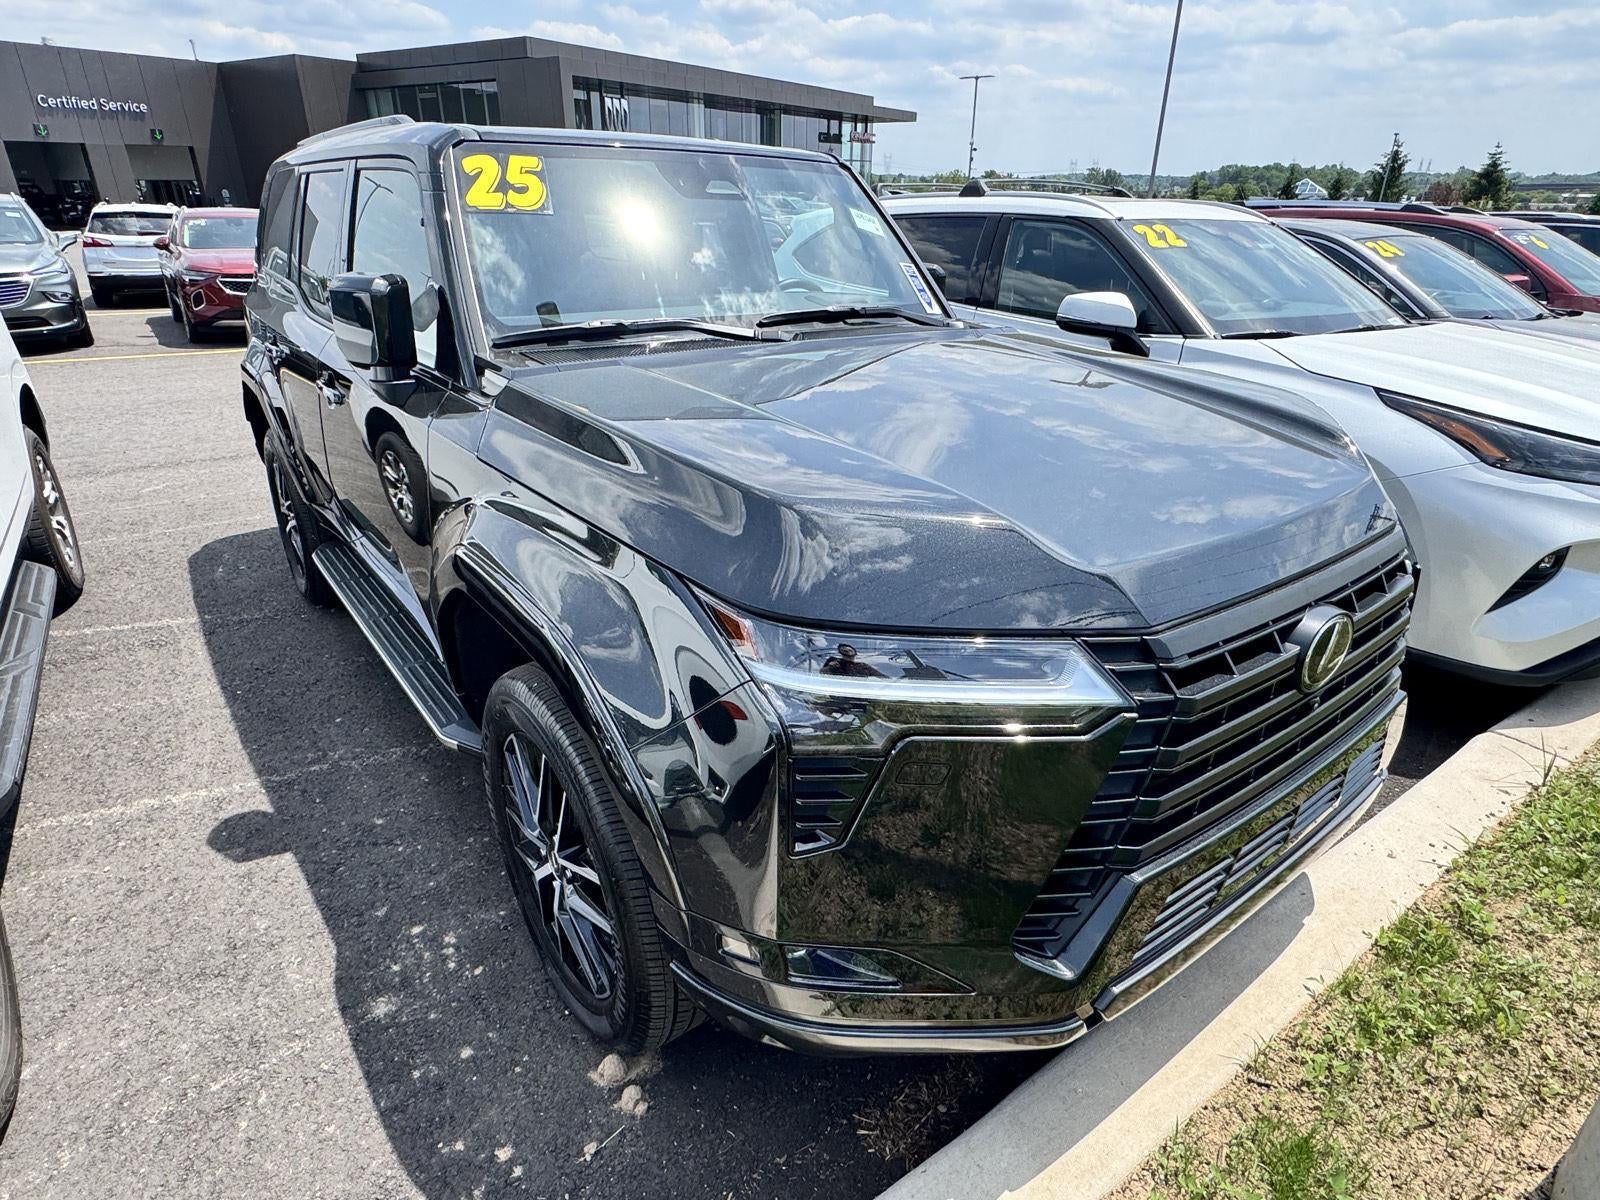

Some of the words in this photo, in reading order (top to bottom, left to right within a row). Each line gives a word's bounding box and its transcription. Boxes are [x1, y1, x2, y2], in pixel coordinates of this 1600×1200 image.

[37, 94, 98, 110] Certified
[99, 98, 148, 112] Service
[461, 154, 547, 210] 25
[1132, 223, 1188, 248] 22
